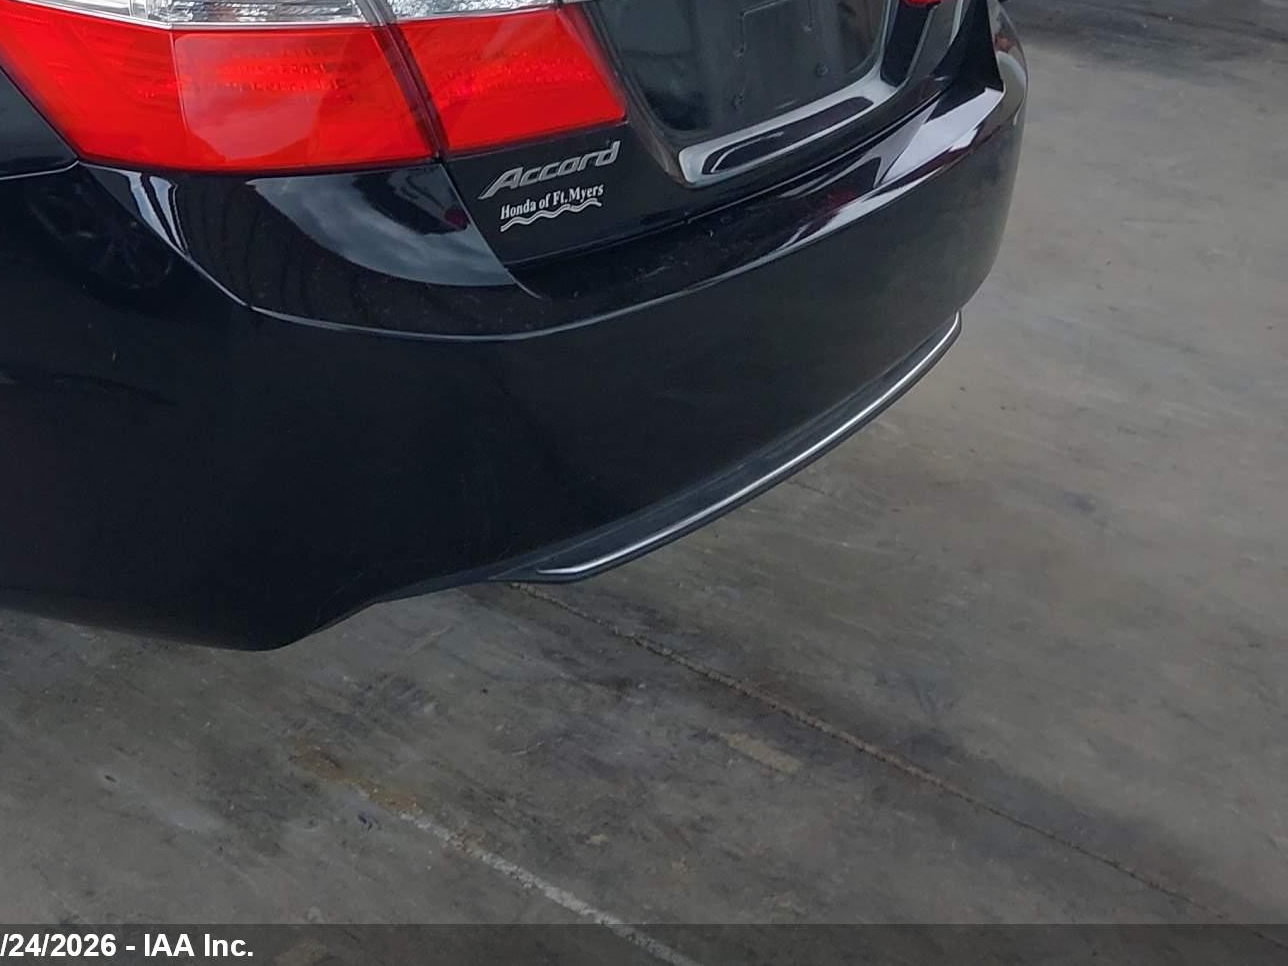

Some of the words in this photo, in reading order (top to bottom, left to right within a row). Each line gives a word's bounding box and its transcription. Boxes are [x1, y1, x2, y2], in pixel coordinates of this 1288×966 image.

[477, 140, 621, 200] Accord
[500, 198, 537, 220] Honda
[538, 193, 551, 209] of
